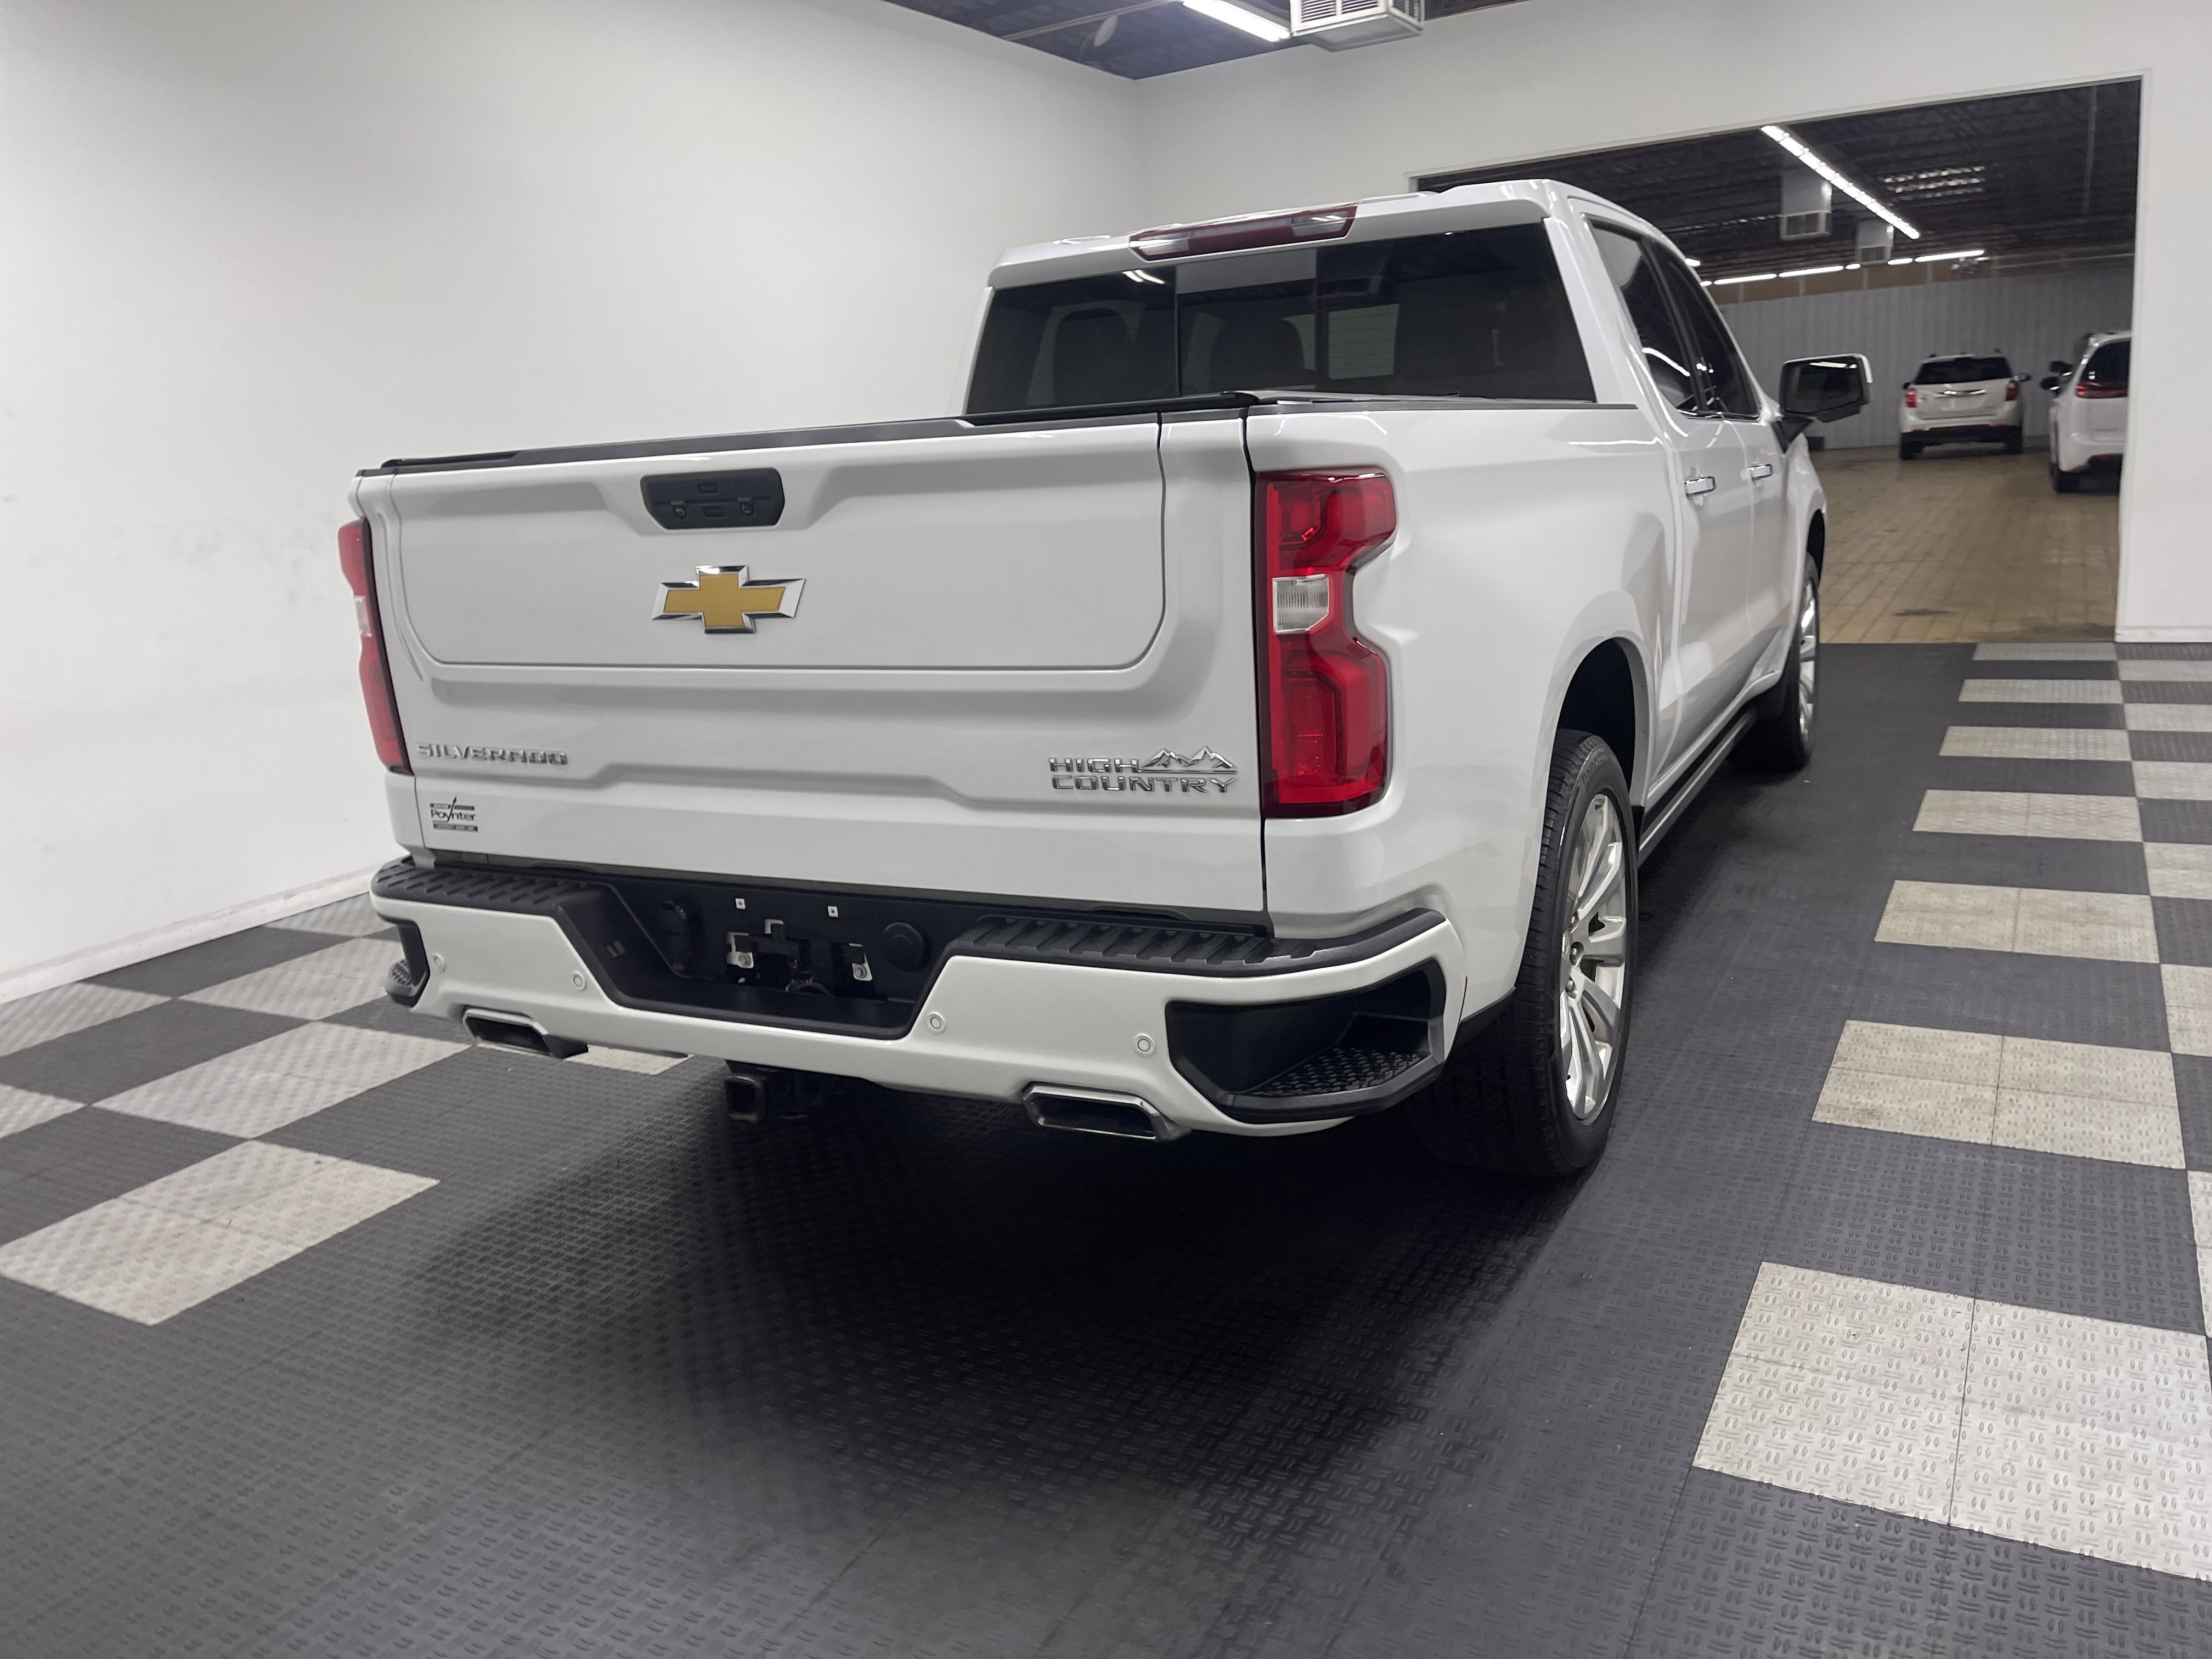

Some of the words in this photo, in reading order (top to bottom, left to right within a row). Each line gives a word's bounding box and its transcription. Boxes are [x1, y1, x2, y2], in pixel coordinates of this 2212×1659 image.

[418, 743, 568, 765] SILVERADO
[1048, 758, 1139, 772] HIGH
[1052, 775, 1237, 793] COUNTRY
[430, 809, 476, 822] Poynter
